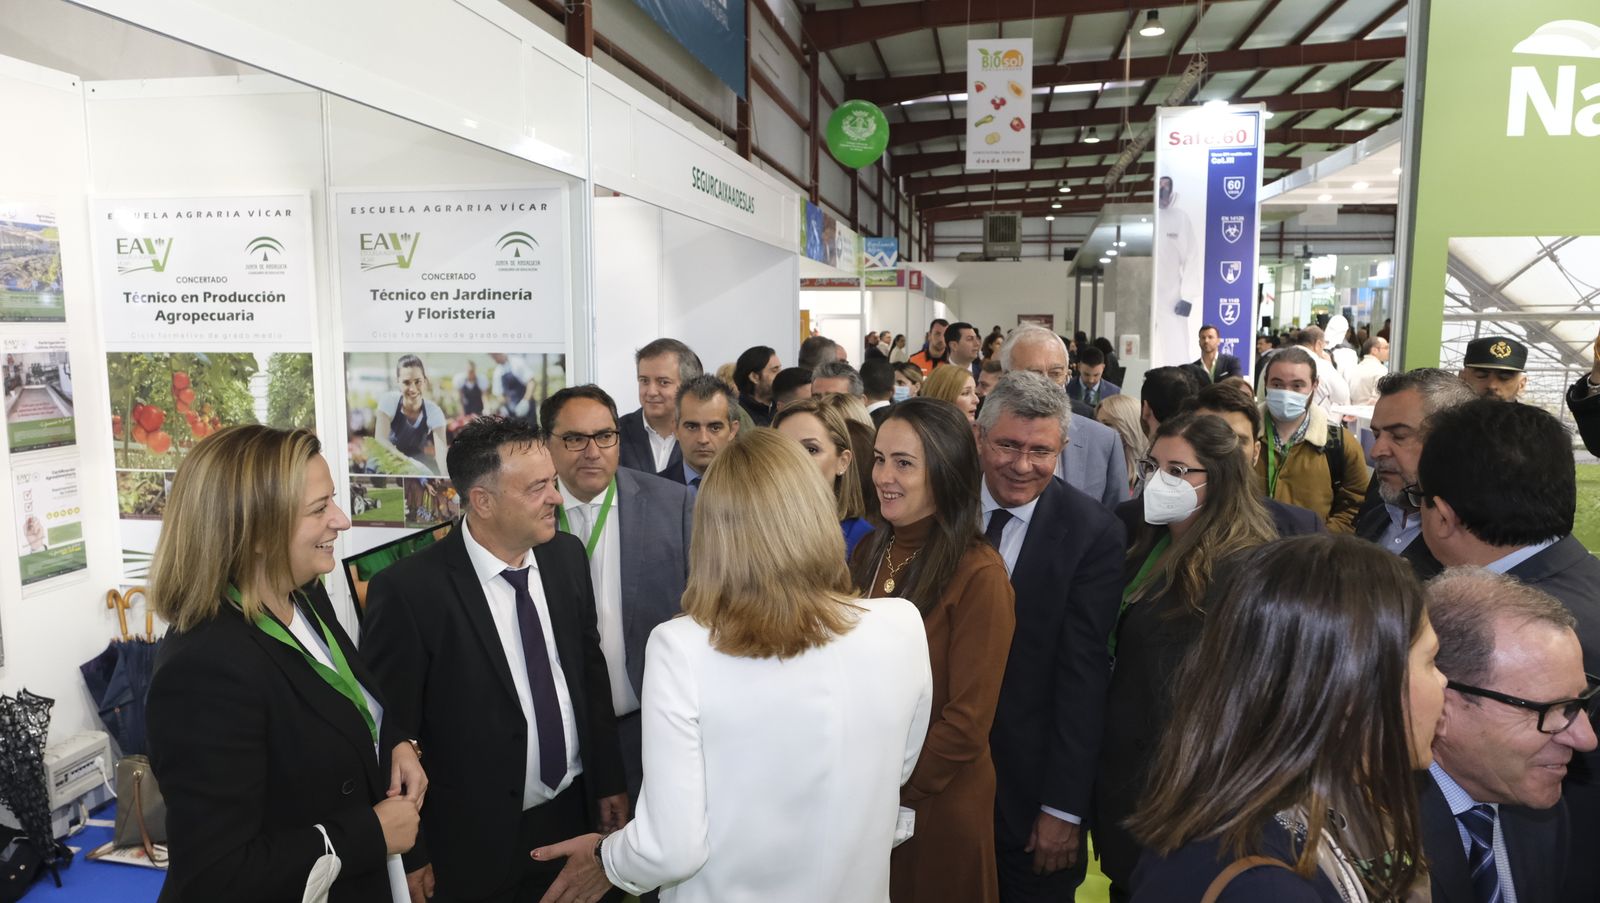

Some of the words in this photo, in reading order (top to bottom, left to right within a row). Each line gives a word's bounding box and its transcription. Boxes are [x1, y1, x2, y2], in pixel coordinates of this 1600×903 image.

[1506, 65, 1600, 137] Na
[692, 166, 755, 214] SEGURCAIXAADESLAS
[1227, 179, 1241, 190] 60
[176, 210, 241, 218] AGRARIA
[248, 208, 292, 217] VÍCAR
[351, 205, 416, 215] ESCUELA
[423, 203, 493, 213] AGRARIA
[500, 202, 548, 211] VÍCAR
[176, 276, 228, 284] CONCERTADO
[421, 272, 476, 281] CONCERTADO
[123, 291, 177, 304] Técnico
[181, 294, 199, 304] en
[203, 290, 286, 303] Producción
[370, 288, 427, 301] Técnico
[430, 291, 449, 301] en
[452, 288, 533, 301] Jardinería
[155, 309, 254, 325] Agropecuaria
[405, 310, 413, 323] y
[417, 307, 496, 320] Floristería
